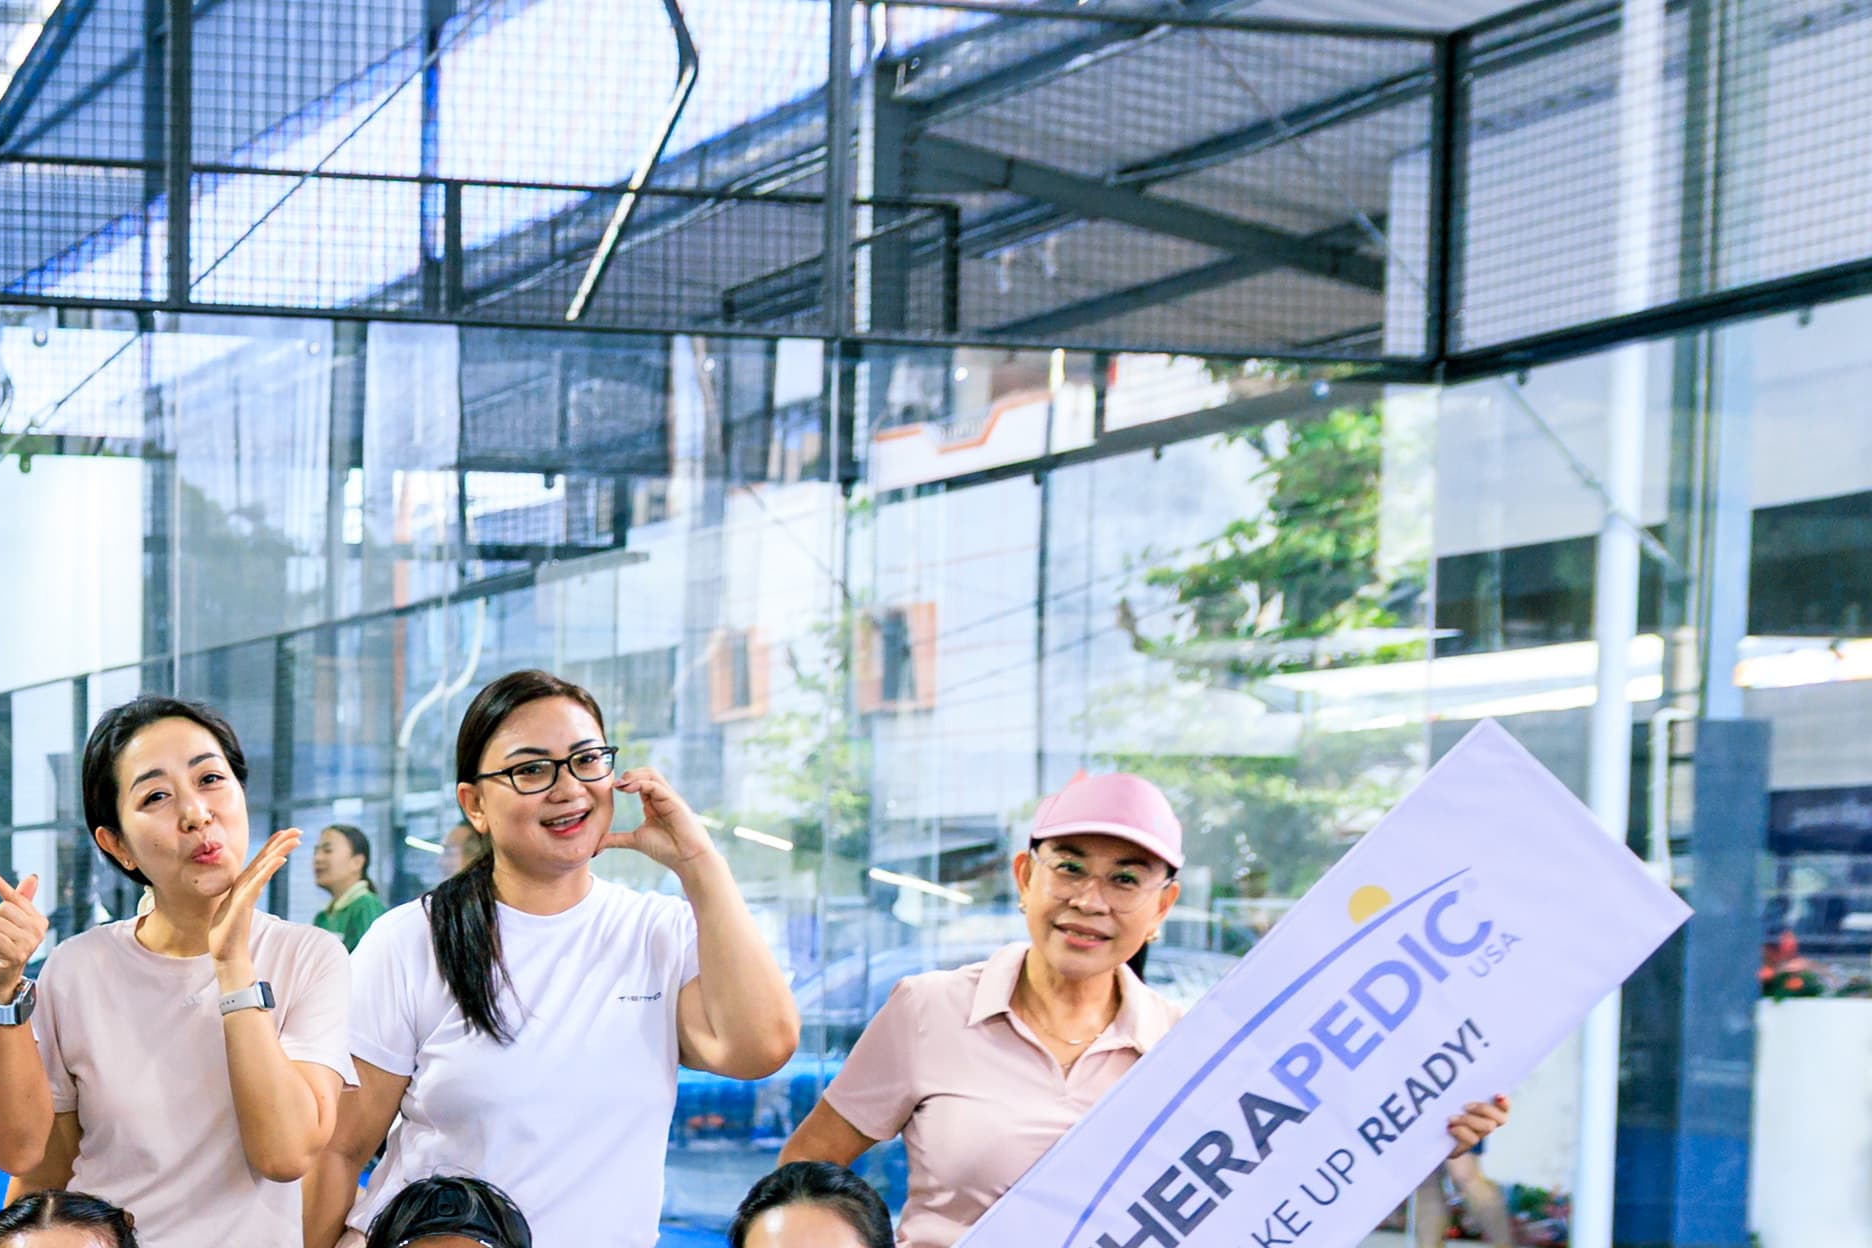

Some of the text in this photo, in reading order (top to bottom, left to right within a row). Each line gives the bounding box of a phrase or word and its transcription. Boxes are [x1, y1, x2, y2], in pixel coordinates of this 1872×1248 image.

[1468, 931, 1522, 979] USA
[1300, 1149, 1355, 1206] UP
[1357, 1018, 1490, 1156] READY!
